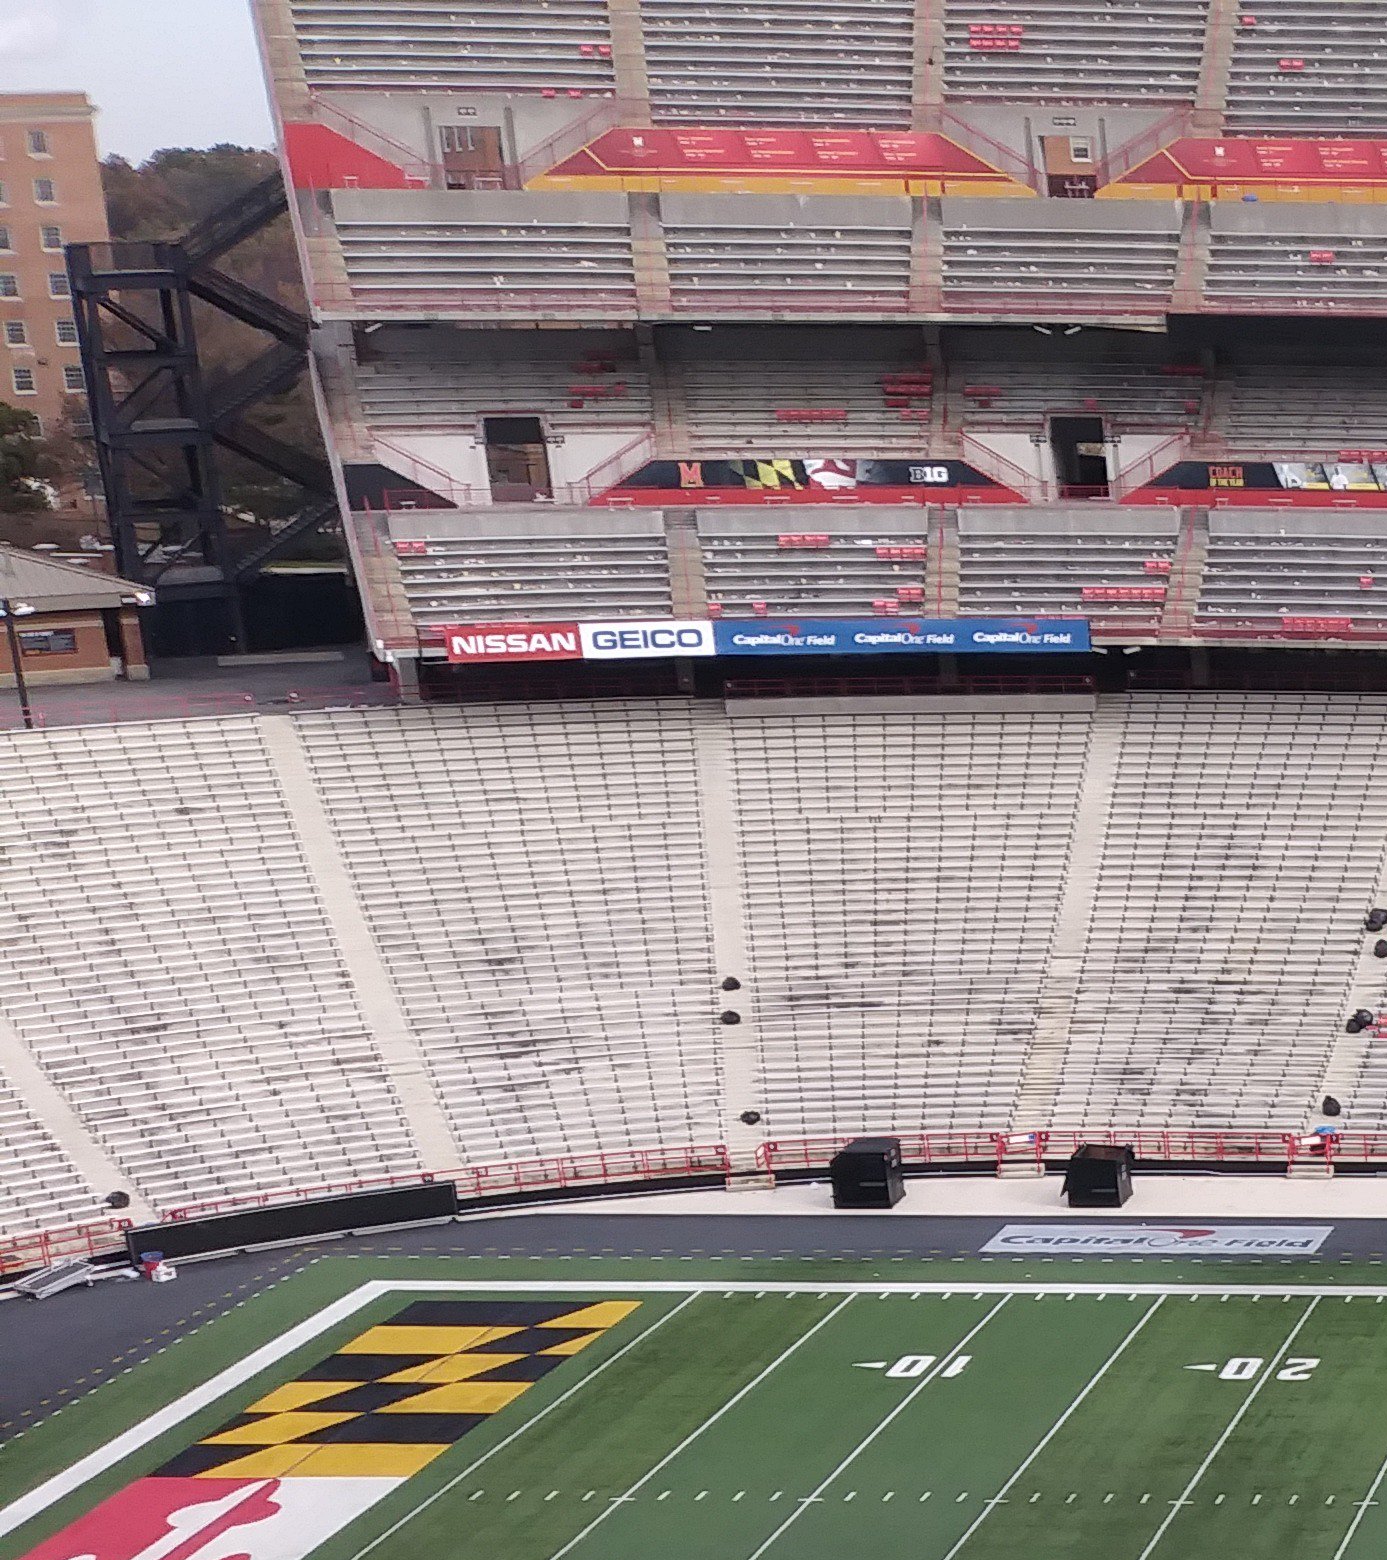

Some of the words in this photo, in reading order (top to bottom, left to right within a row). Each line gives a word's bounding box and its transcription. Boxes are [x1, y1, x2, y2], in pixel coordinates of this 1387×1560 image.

[451, 632, 577, 655] NISSAN
[592, 628, 703, 650] GEICO
[805, 633, 836, 647] Field
[926, 632, 955, 646] Field
[1043, 631, 1072, 645] Field
[1223, 1237, 1314, 1249] Field
